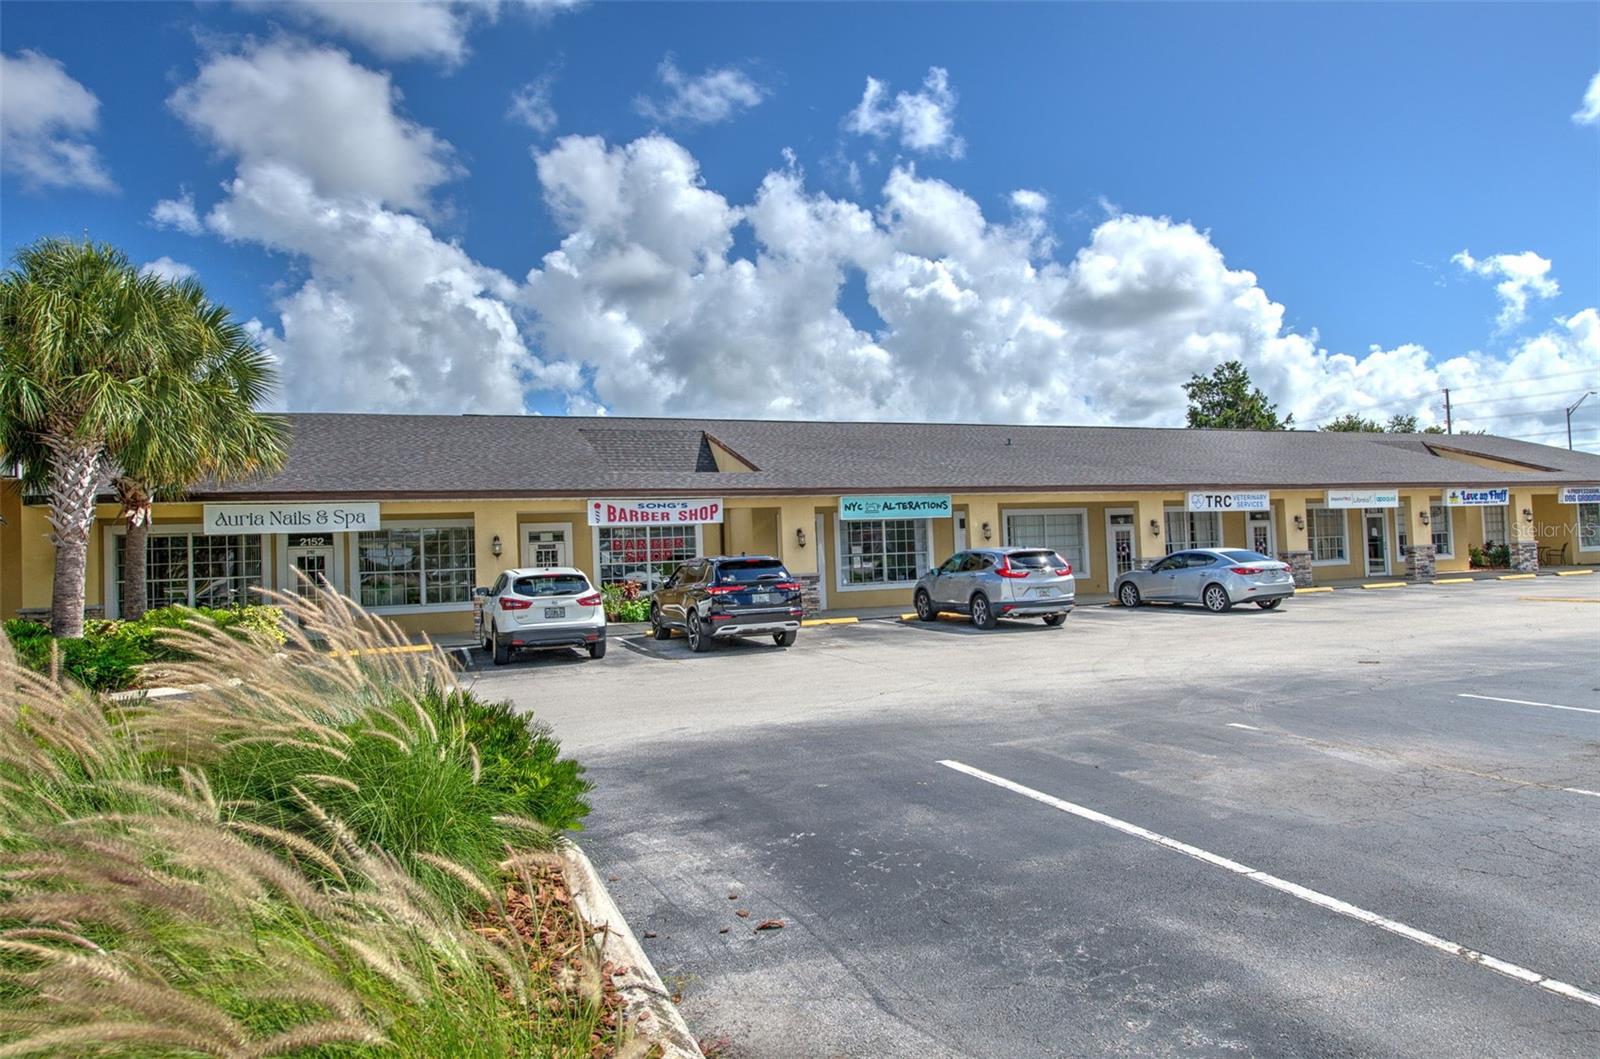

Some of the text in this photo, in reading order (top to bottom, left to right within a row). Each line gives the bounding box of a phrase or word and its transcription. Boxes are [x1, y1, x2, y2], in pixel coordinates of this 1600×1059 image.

[844, 500, 948, 511] NYC ALTERATIONS
[1205, 495, 1232, 507] TRC
[215, 509, 366, 528] Auria Nails & Spa
[607, 503, 719, 522] BARBER SHOP
[300, 537, 325, 546] 2152
[613, 538, 684, 551] BARBER
[625, 551, 673, 563] SHOP
